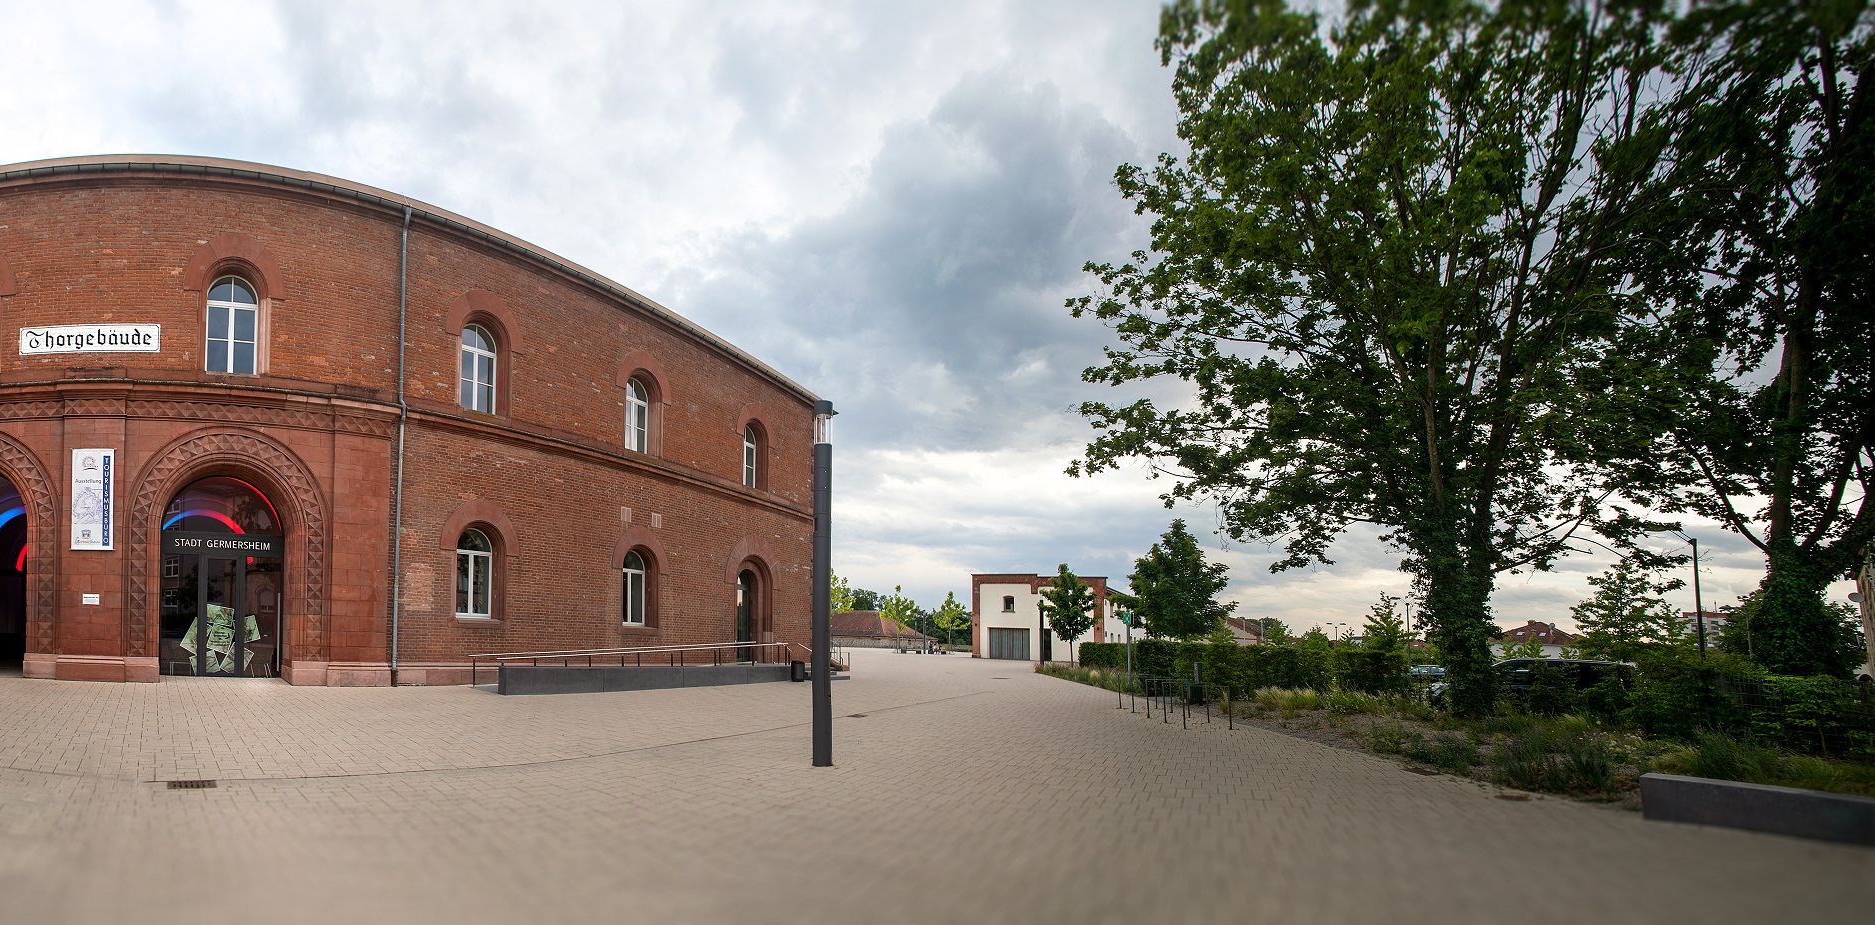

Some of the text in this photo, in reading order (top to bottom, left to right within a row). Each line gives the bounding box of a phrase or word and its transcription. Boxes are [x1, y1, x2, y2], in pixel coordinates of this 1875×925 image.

[26, 328, 152, 349] Thorgebäude
[174, 538, 270, 550] STADT GERMERSHEIM
